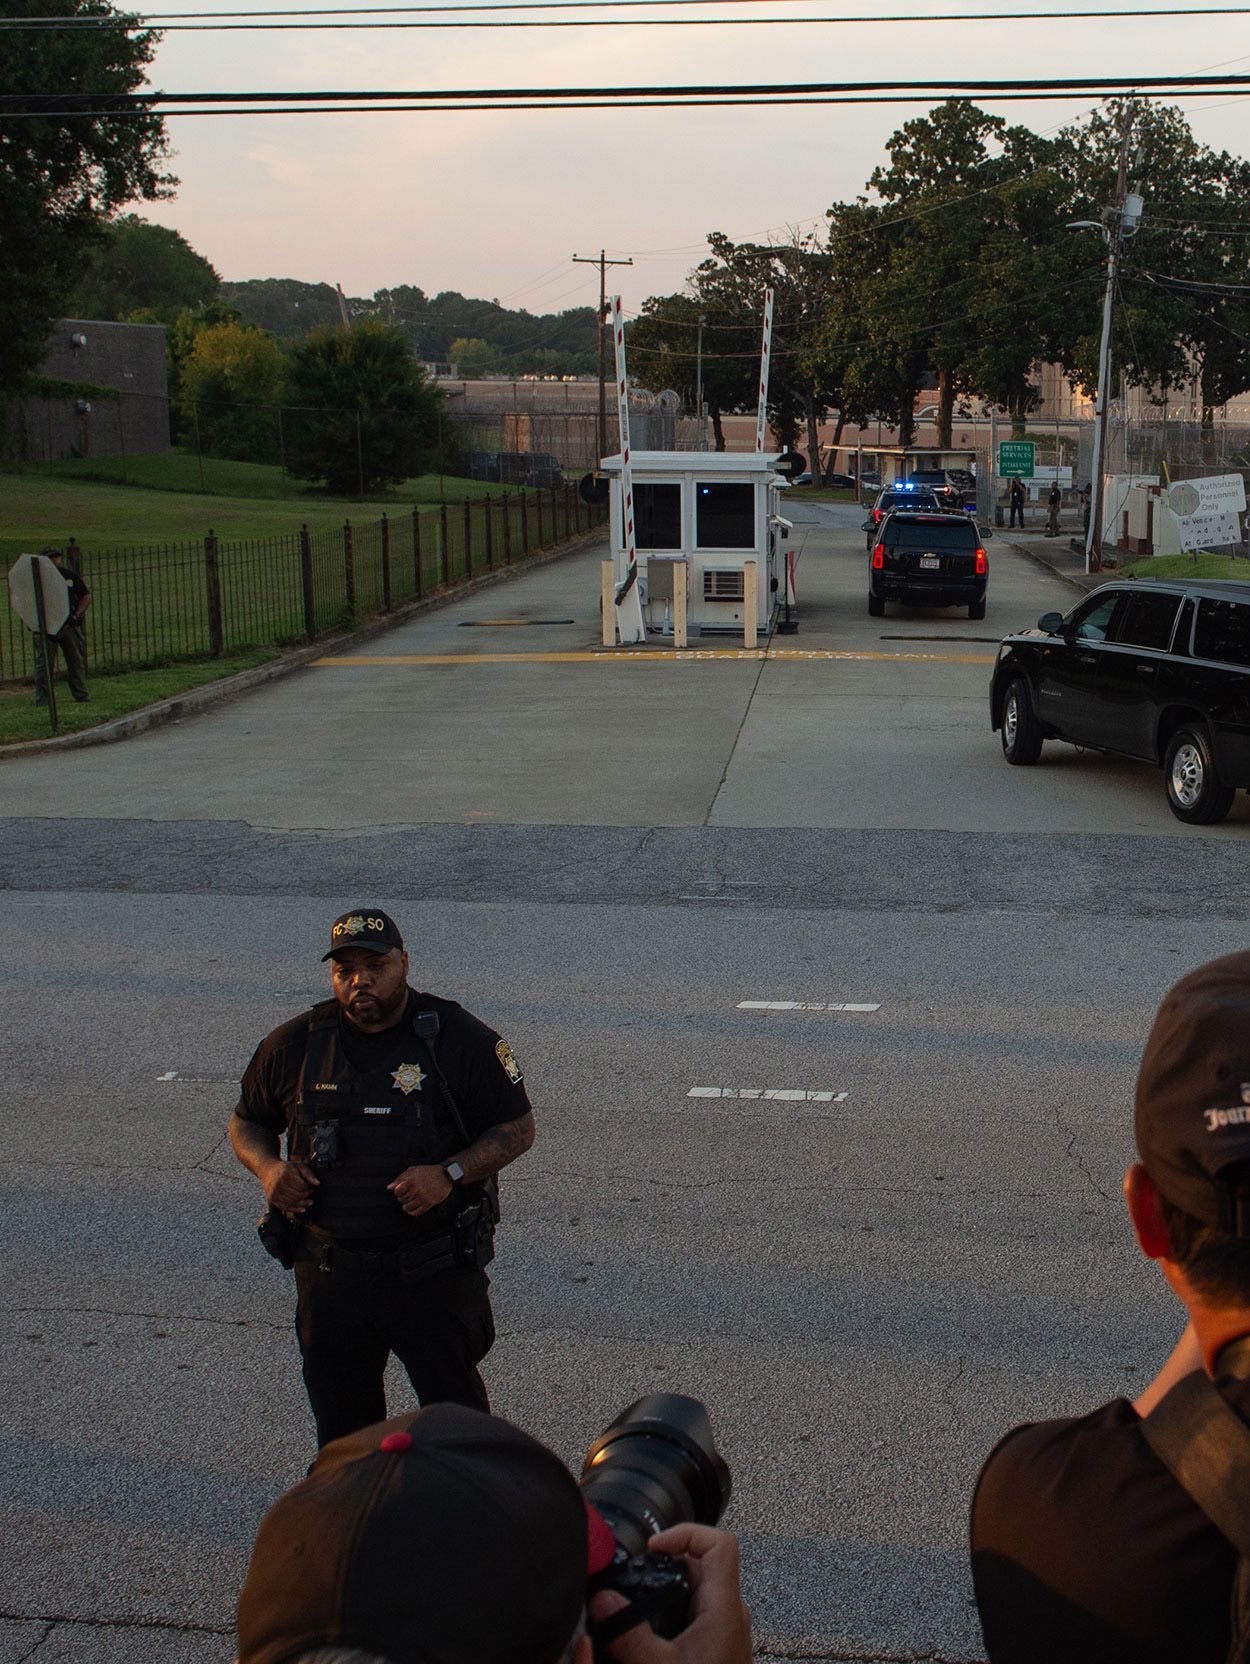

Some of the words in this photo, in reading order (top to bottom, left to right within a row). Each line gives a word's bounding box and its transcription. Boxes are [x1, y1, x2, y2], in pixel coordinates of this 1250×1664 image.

[1200, 480, 1240, 490] Authorized
[1171, 493, 1197, 508] STOP
[1200, 491, 1239, 501] Personnel
[1202, 503, 1219, 511] Only
[367, 917, 384, 931] SO
[363, 1107, 392, 1115] SHERIFF
